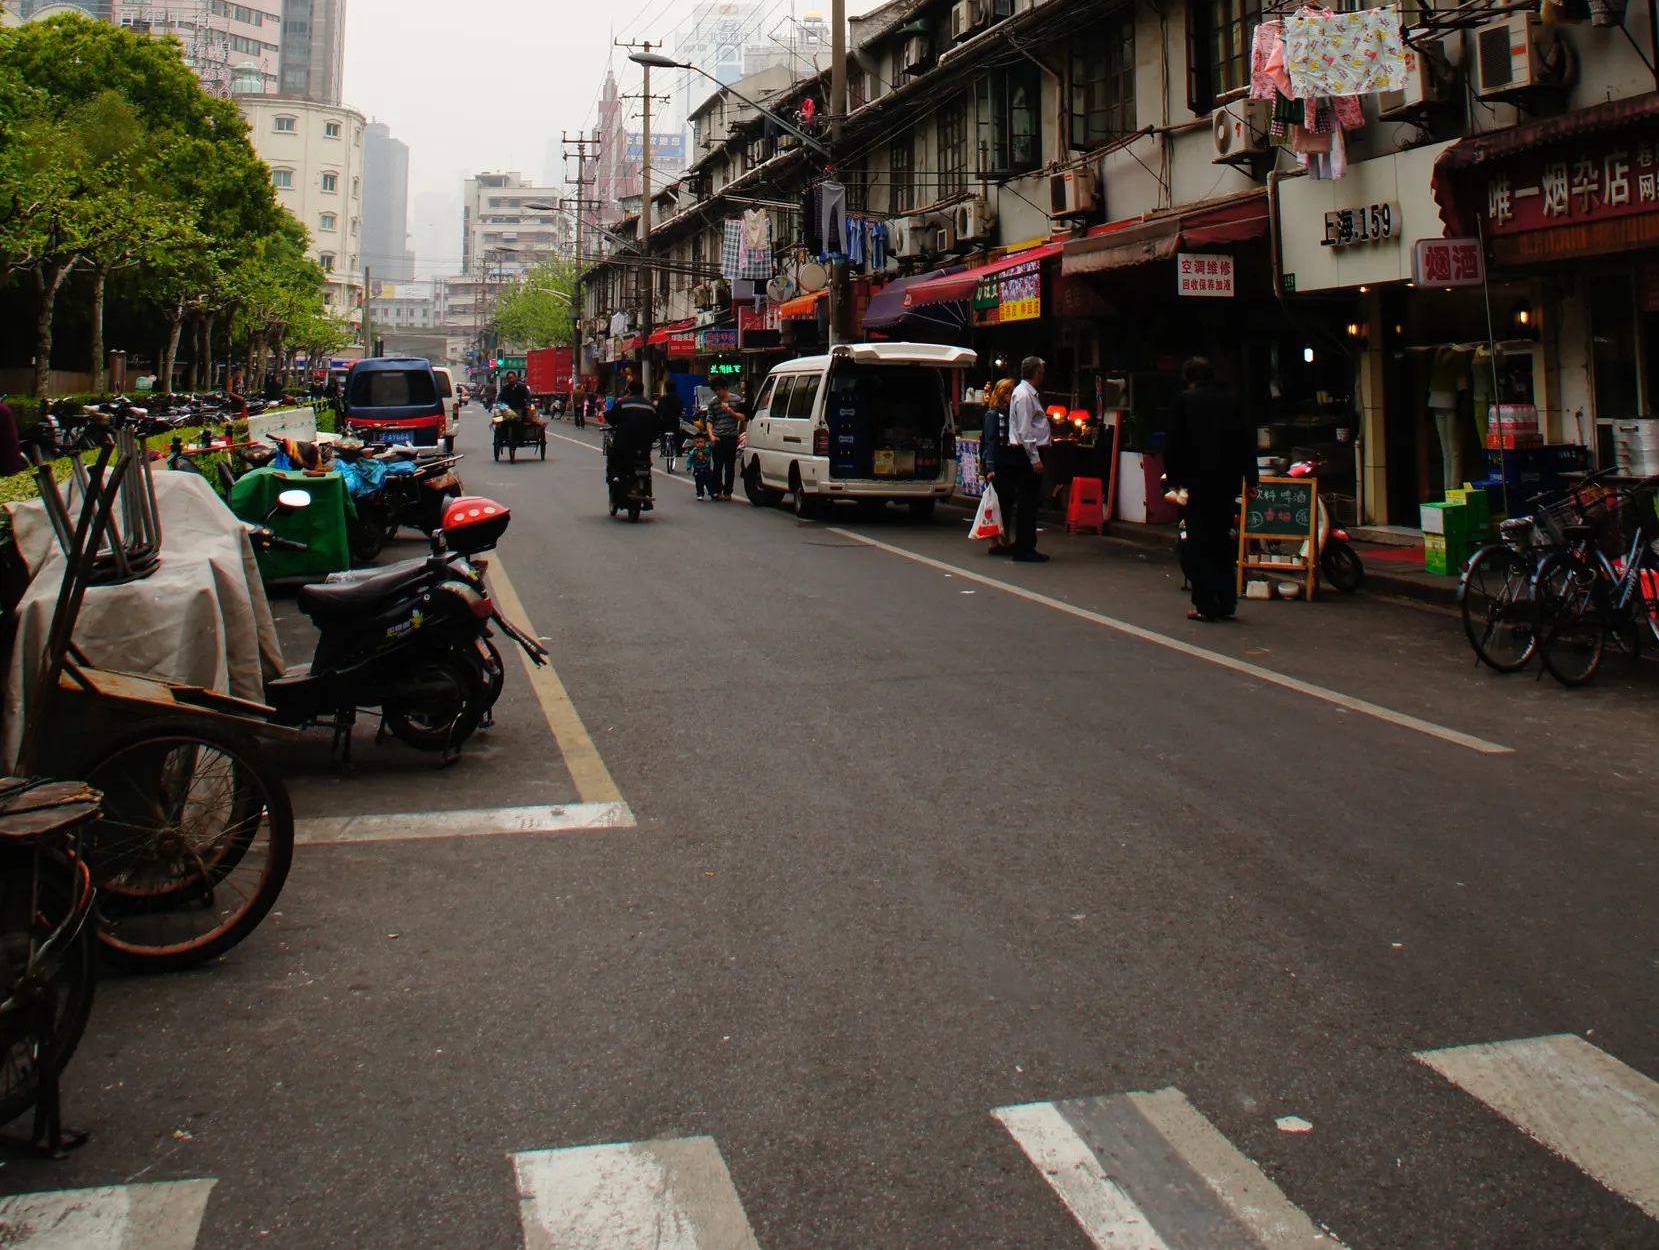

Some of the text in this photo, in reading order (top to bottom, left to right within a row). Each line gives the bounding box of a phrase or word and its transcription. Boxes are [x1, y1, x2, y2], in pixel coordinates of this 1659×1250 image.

[1486, 144, 1629, 227] 唯一烟杂店
[1638, 170, 1659, 204] 网
[1181, 259, 1231, 276] 空调维修
[1425, 245, 1478, 282] 烟酒
[1182, 278, 1231, 292] 回收保养加液
